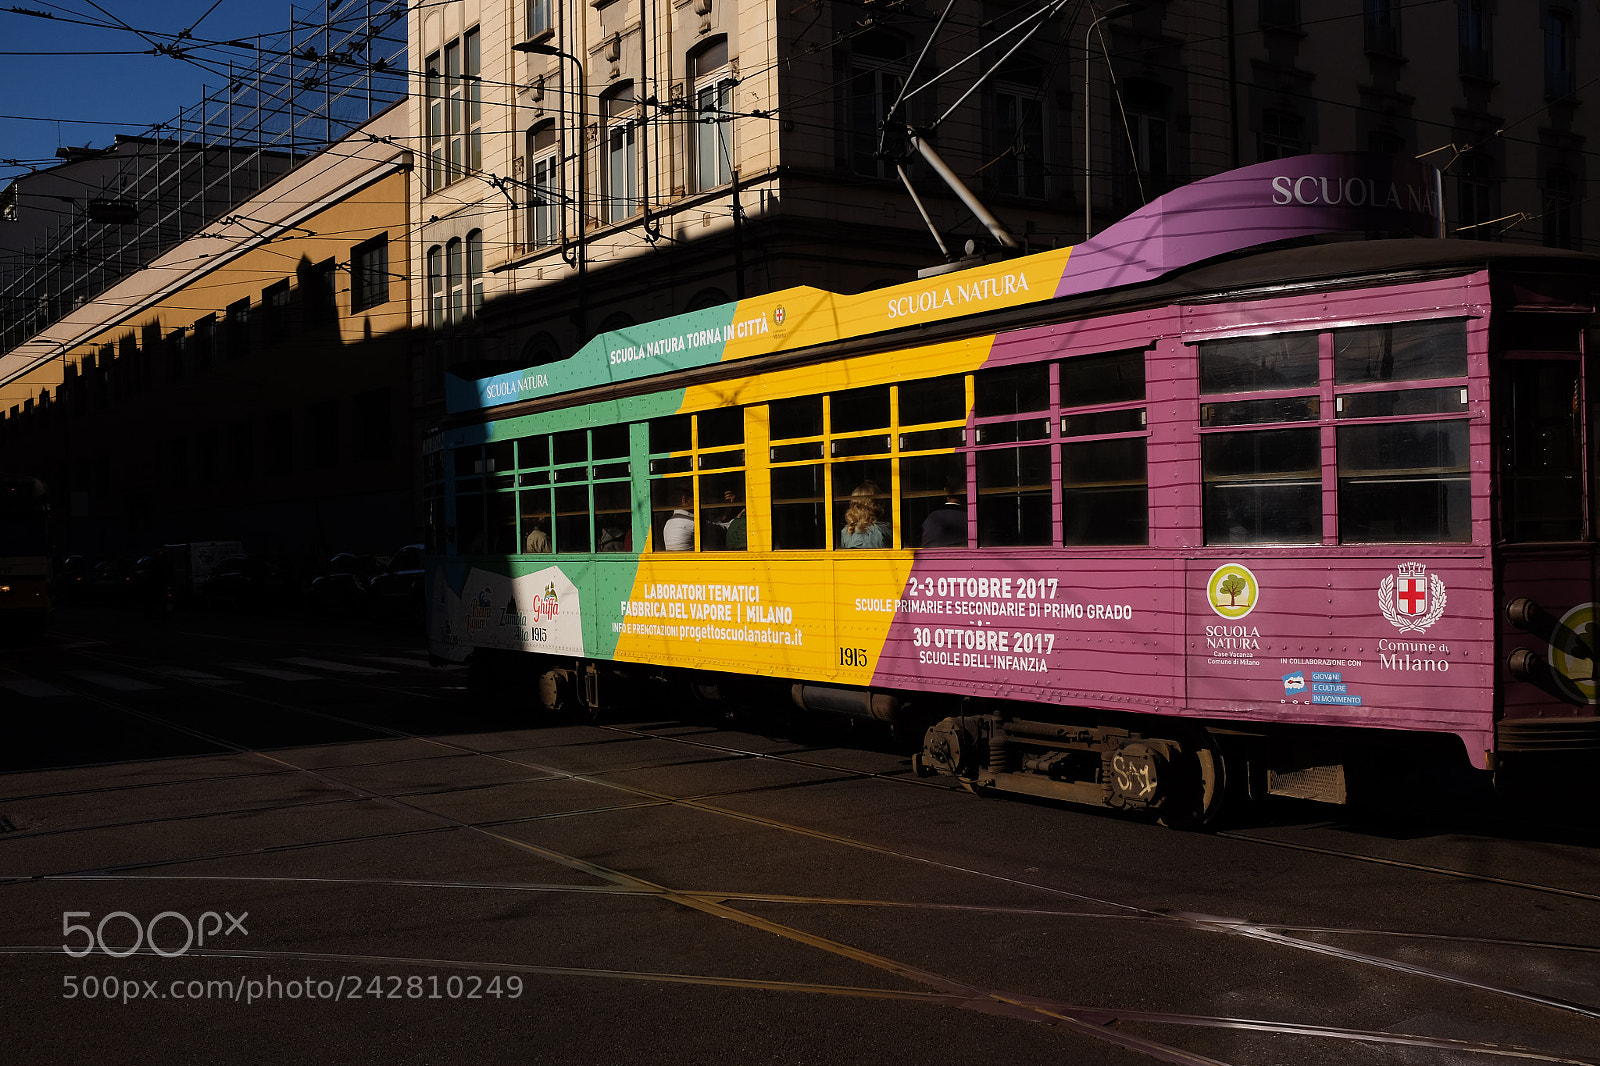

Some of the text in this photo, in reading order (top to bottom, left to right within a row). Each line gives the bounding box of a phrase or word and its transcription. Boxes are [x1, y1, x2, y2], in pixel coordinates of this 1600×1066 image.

[1272, 175, 1403, 210] SCUOLA
[888, 272, 1029, 318] SCUOLA NATURA
[610, 344, 645, 365] SCUOLA
[647, 338, 685, 360] NATURA
[687, 330, 722, 351] TORNA
[723, 326, 735, 342] IN
[737, 312, 769, 338] CITTÀ
[486, 374, 549, 399] SCUOLA NATURA
[644, 584, 760, 602] LABORATORI TEMATICI
[909, 577, 1059, 599] 2-3 OTTOBRE 2017
[533, 595, 559, 622] Ghiffa
[621, 601, 667, 618] FABBRICA
[669, 603, 689, 619] DEL
[689, 603, 732, 621] VAPORE
[746, 606, 793, 624] MILANO
[855, 598, 1132, 620] SCUOLE PRIMARIE E SECONDARIE DI PRIMO GRADO
[531, 627, 547, 642] 1915
[612, 622, 803, 646] INFO E PRENOTAZIONI progettoscuolanatura.it
[913, 627, 1055, 655] 30 OTTOBRE 2017
[1205, 625, 1261, 637] SCUOLA
[1206, 638, 1260, 650] NATURA
[1378, 638, 1450, 653] Comune di
[840, 647, 868, 667] 1915
[919, 651, 1048, 673] SCUOLE DELL'INFANZIA
[1289, 658, 1346, 667] COLLABORAZIONE
[1347, 659, 1362, 667] CON
[1379, 653, 1449, 672] Milano
[1313, 673, 1340, 681] GIOVANI
[1318, 684, 1346, 692] CULTURE
[1321, 696, 1361, 704] MOVIMENTO
